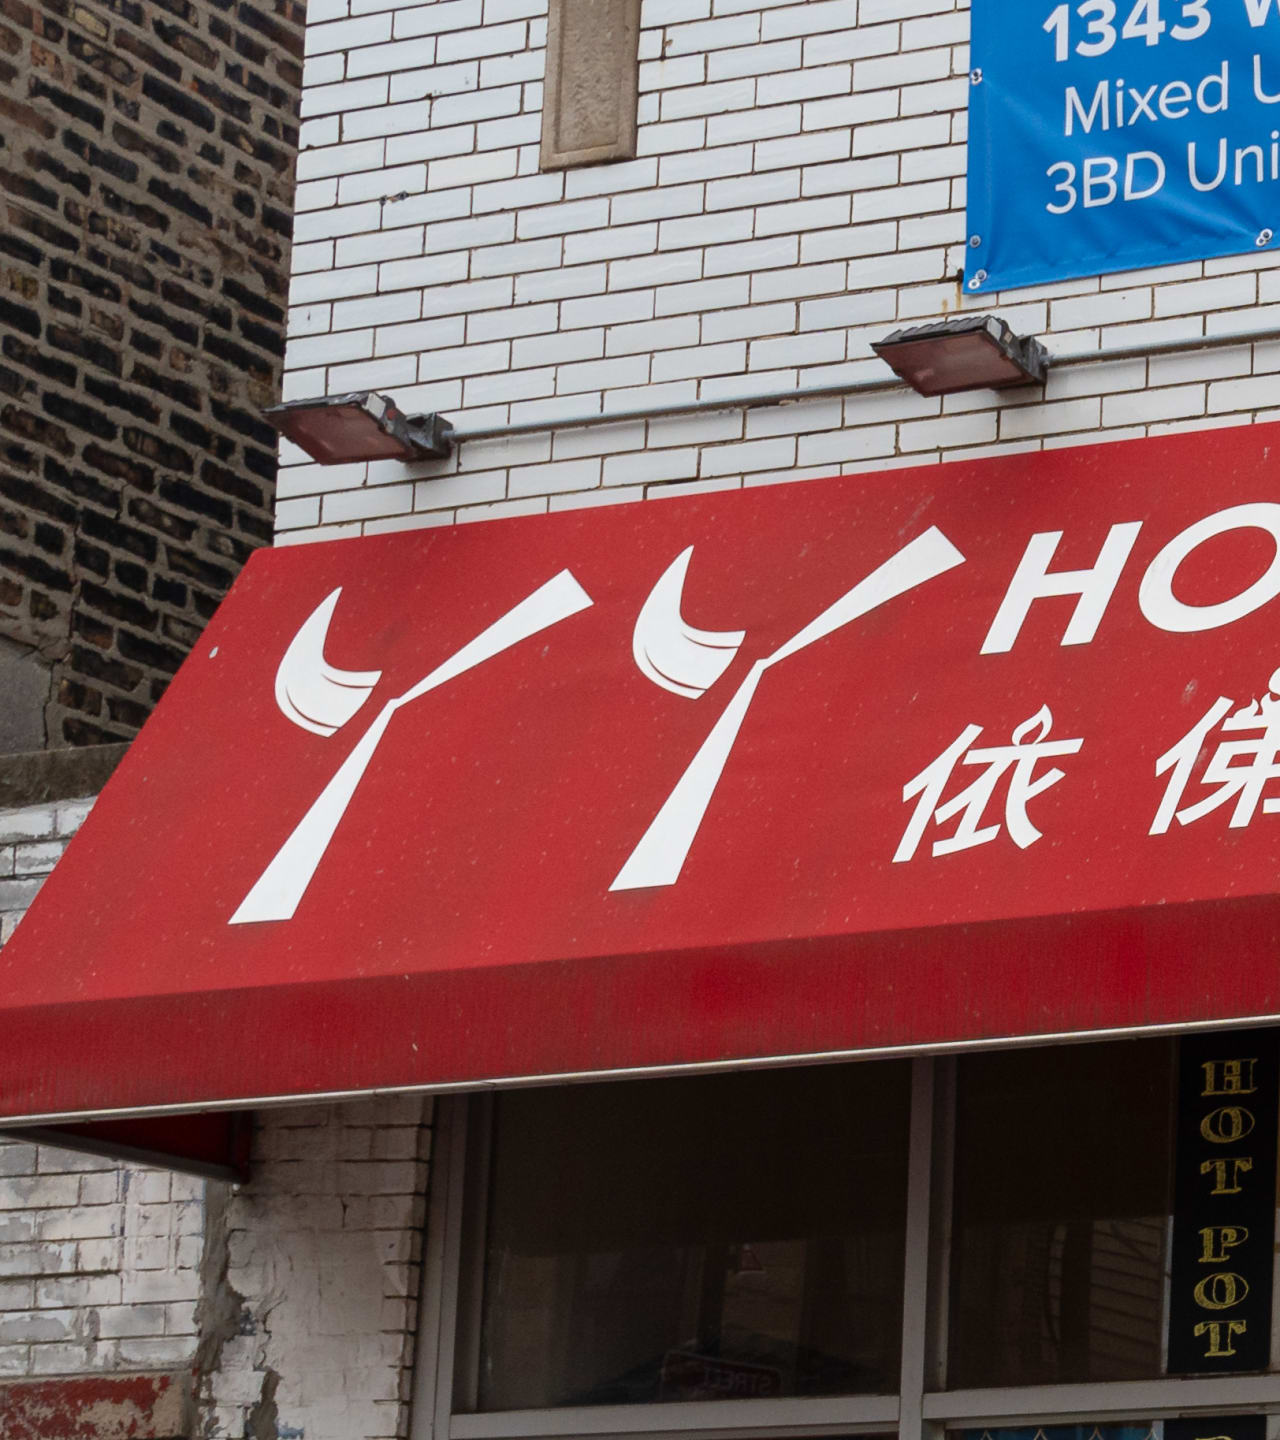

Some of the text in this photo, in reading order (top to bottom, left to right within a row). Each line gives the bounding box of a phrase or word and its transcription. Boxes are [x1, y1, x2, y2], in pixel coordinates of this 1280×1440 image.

[1042, 0, 1211, 62] 1343
[1063, 61, 1230, 137] Mixed
[1046, 150, 1166, 216] 3BD
[1194, 1058, 1258, 1357] HOT POT
